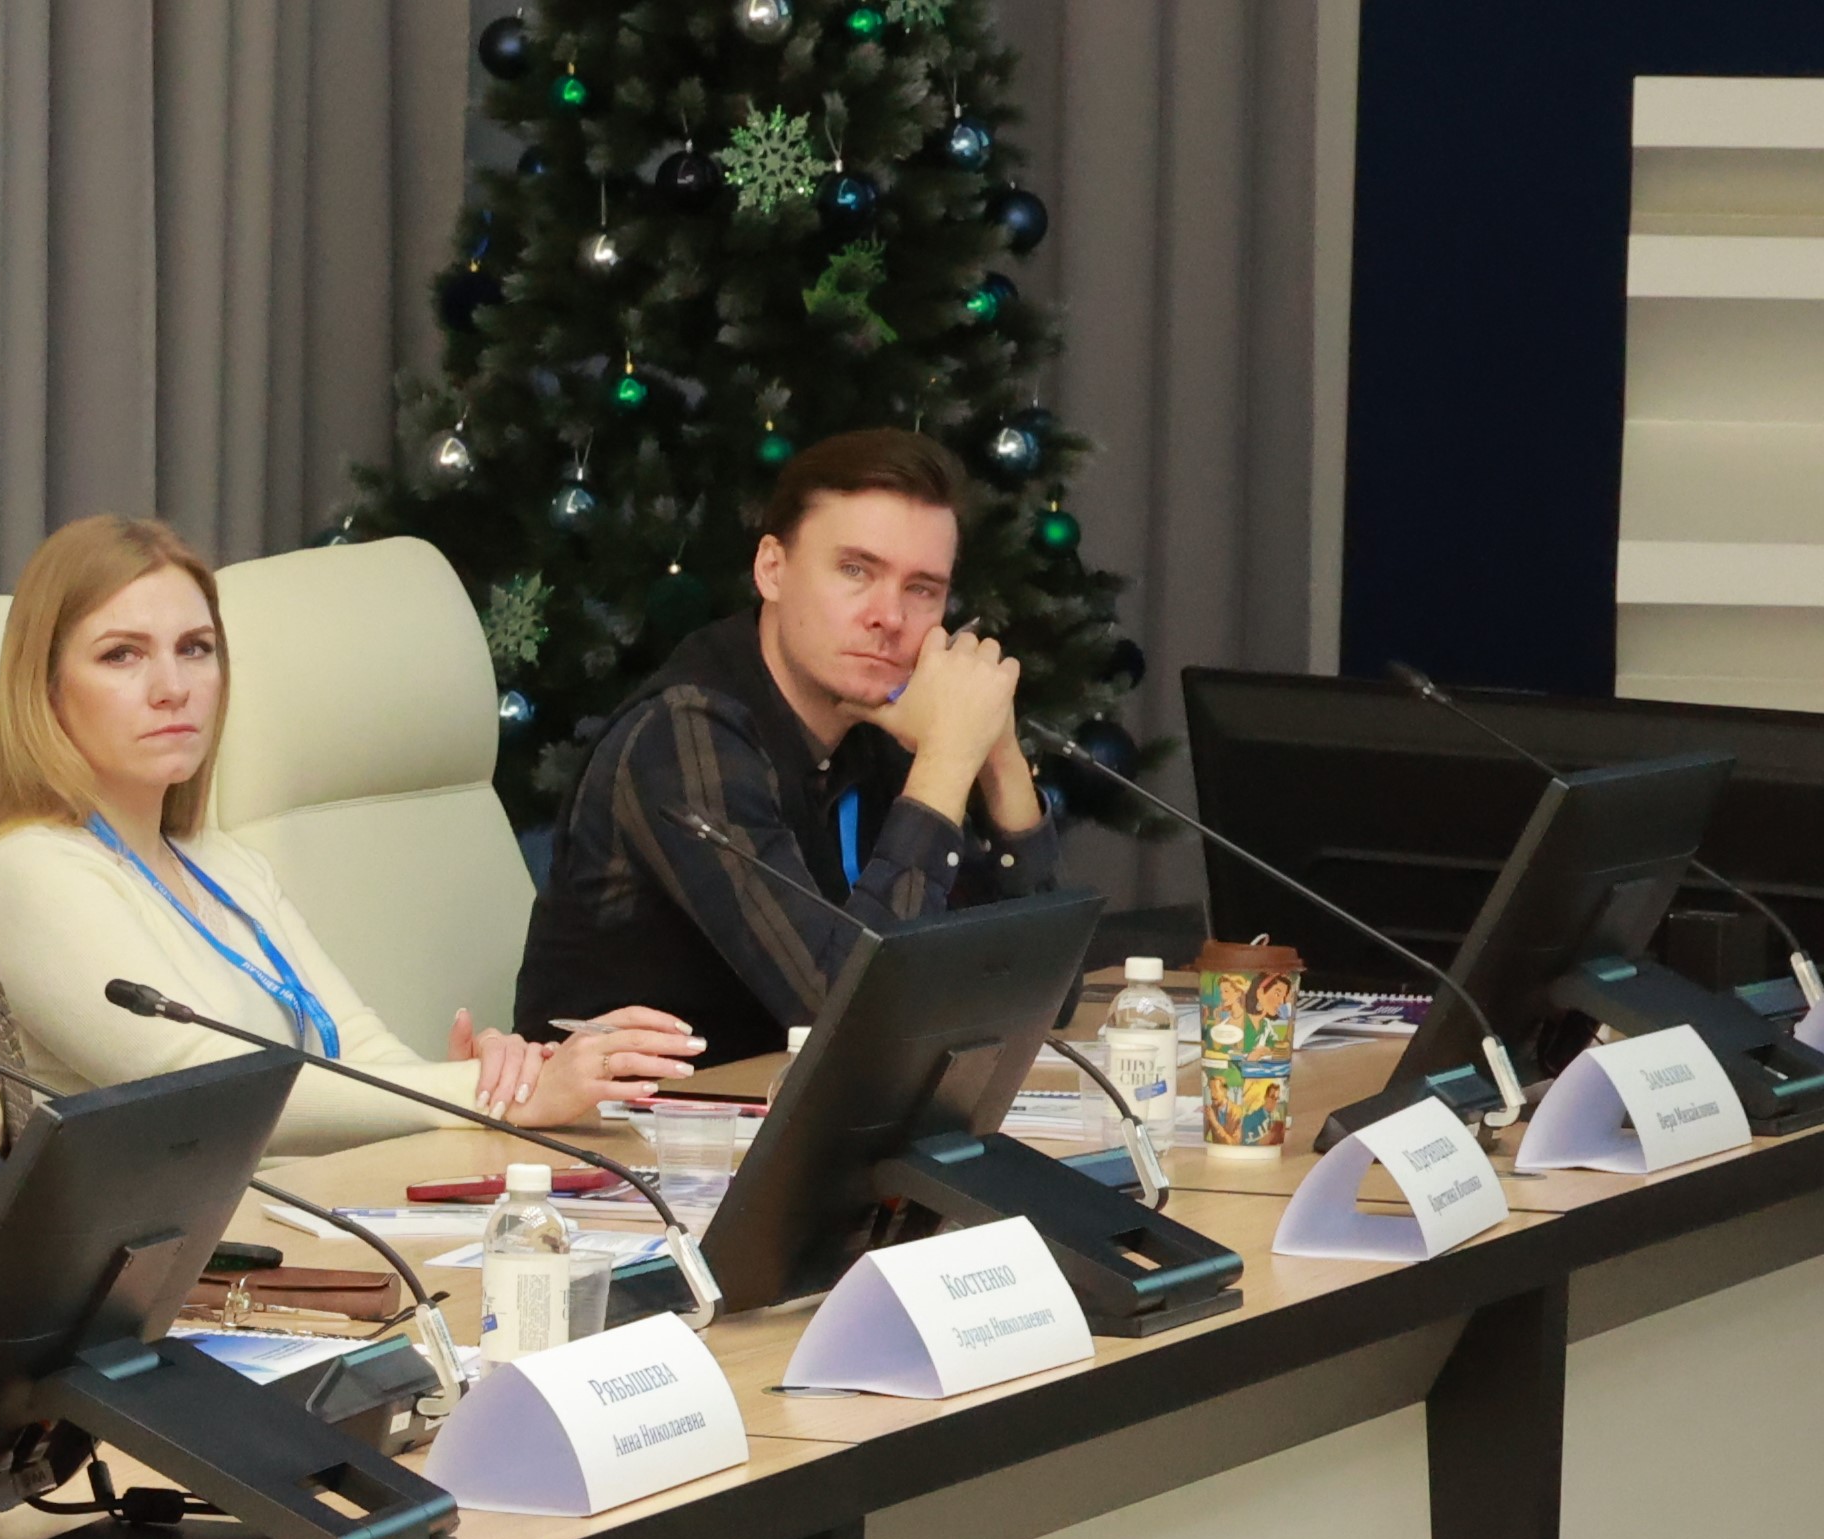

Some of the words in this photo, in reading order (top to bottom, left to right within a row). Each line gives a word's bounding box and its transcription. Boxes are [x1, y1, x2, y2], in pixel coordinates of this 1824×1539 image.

[940, 1264, 1016, 1300] КОСТЕНКО
[952, 1322, 995, 1350] Эдуард
[989, 1308, 1056, 1338] Николаевич
[588, 1362, 678, 1406] РЯБЫШЕВА
[612, 1434, 642, 1457] Анна
[639, 1411, 706, 1443] Николаевна
